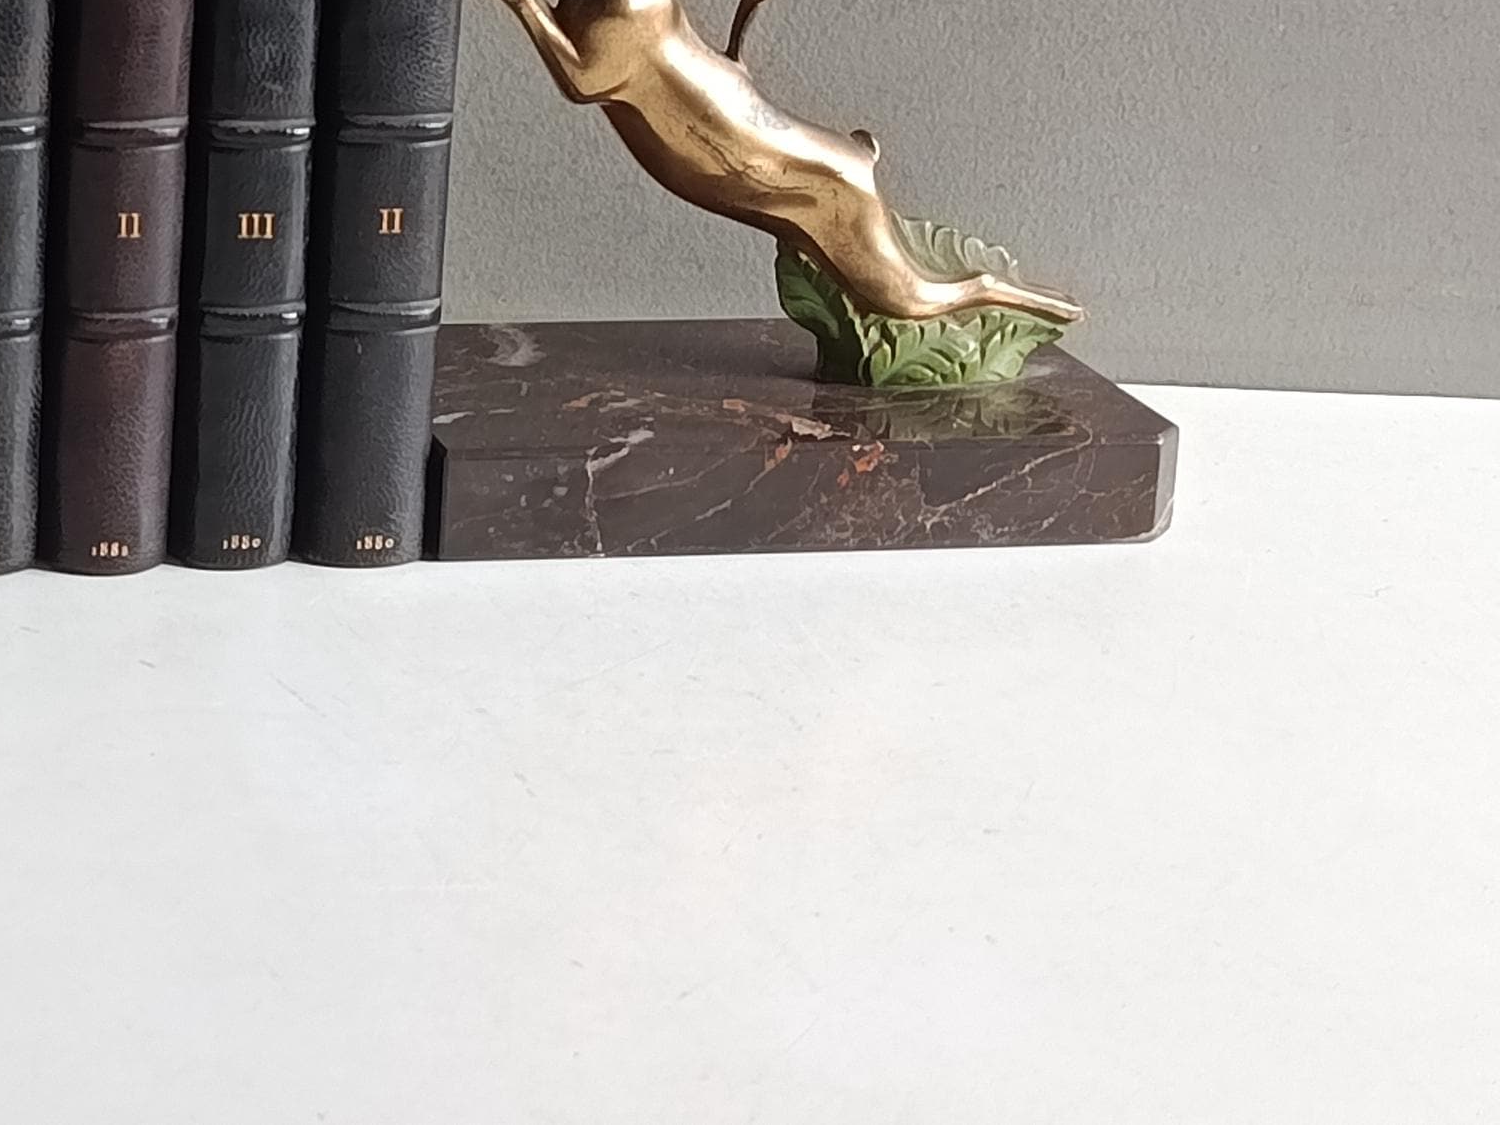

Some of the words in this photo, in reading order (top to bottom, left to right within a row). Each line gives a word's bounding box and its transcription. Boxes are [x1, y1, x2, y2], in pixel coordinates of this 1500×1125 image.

[118, 213, 141, 238] II
[238, 213, 275, 238] III
[379, 208, 403, 234] II
[222, 535, 261, 549] 1880
[356, 535, 394, 550] 1880
